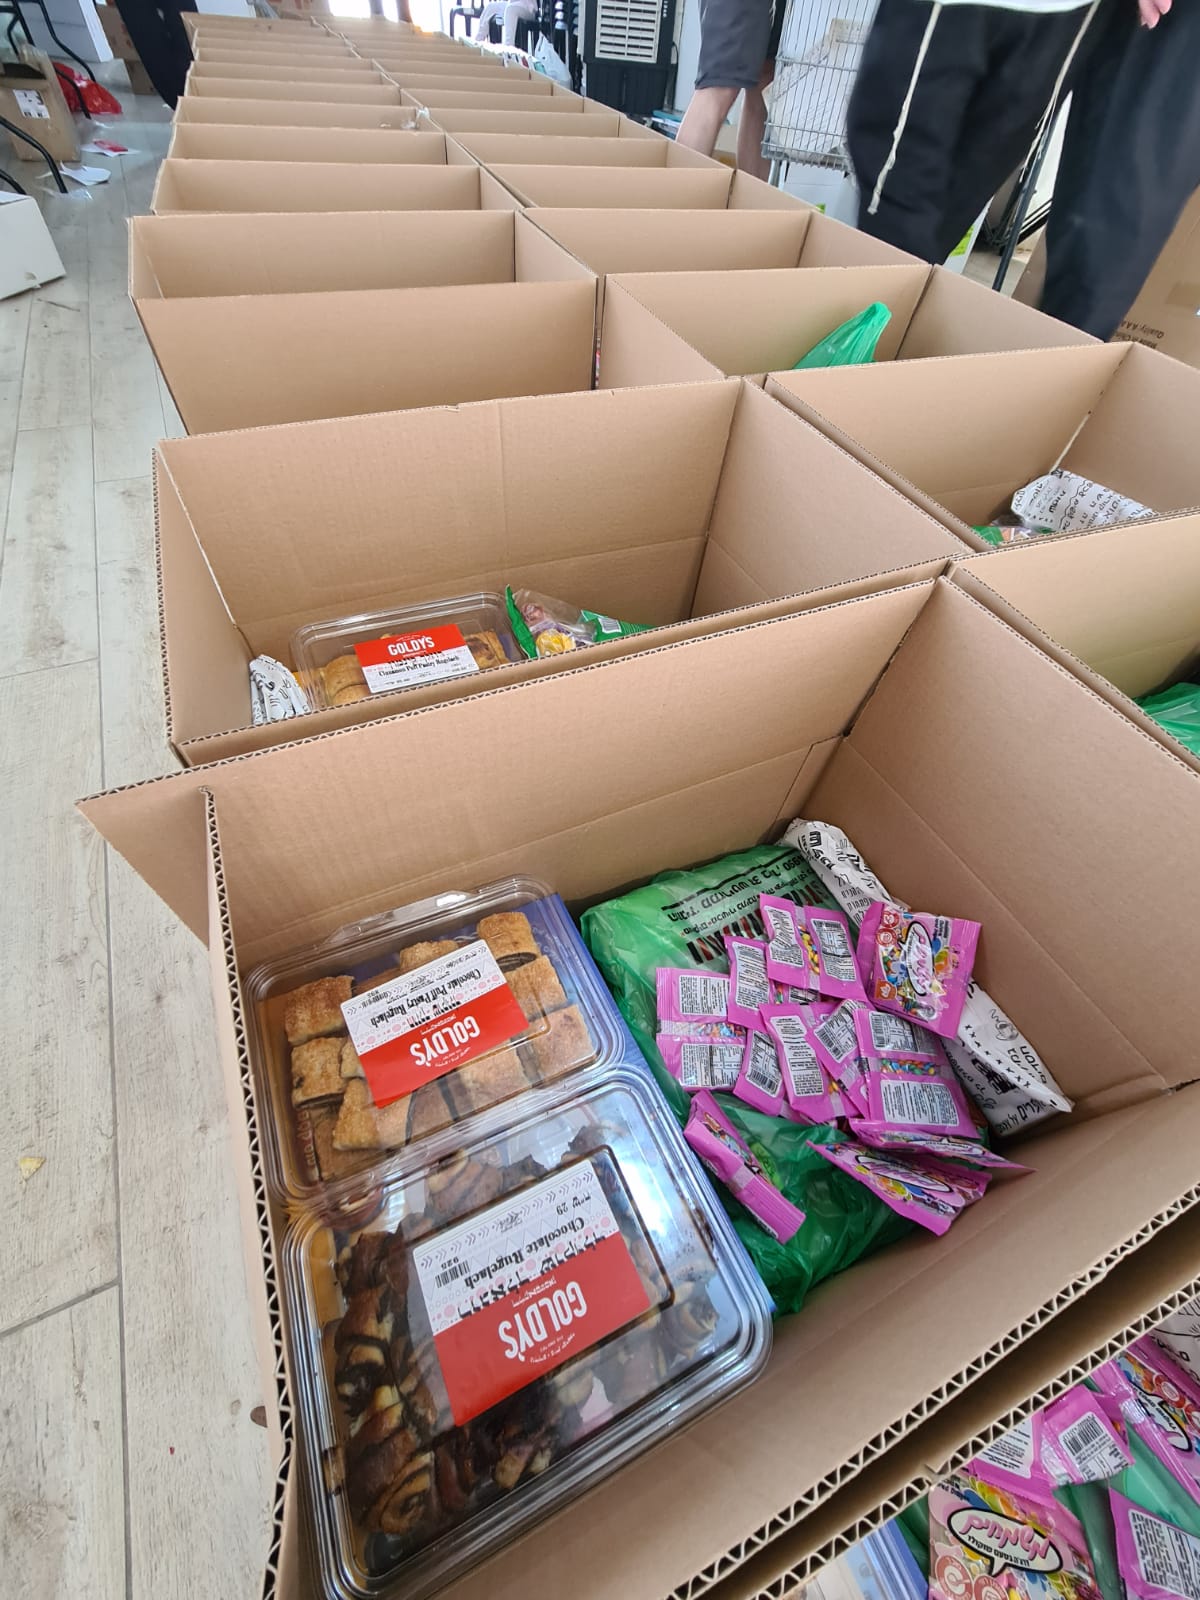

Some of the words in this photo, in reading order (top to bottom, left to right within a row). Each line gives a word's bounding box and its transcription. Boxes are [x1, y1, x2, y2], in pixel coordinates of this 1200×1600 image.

[388, 636, 435, 655] GOLDY'S
[446, 968, 481, 990] Chocolate
[406, 992, 430, 1011] Pastry
[429, 984, 447, 1000] Puff
[370, 1005, 406, 1028] Rugelach
[409, 1015, 481, 1066] GOLDY'S
[555, 1202, 568, 1215] 29
[526, 1216, 586, 1255] Chocolate
[440, 1257, 459, 1269] 925
[464, 1250, 524, 1290] Rugelach
[496, 1281, 589, 1360] GOLDY'S
[960, 1514, 1050, 1560] משמחים
